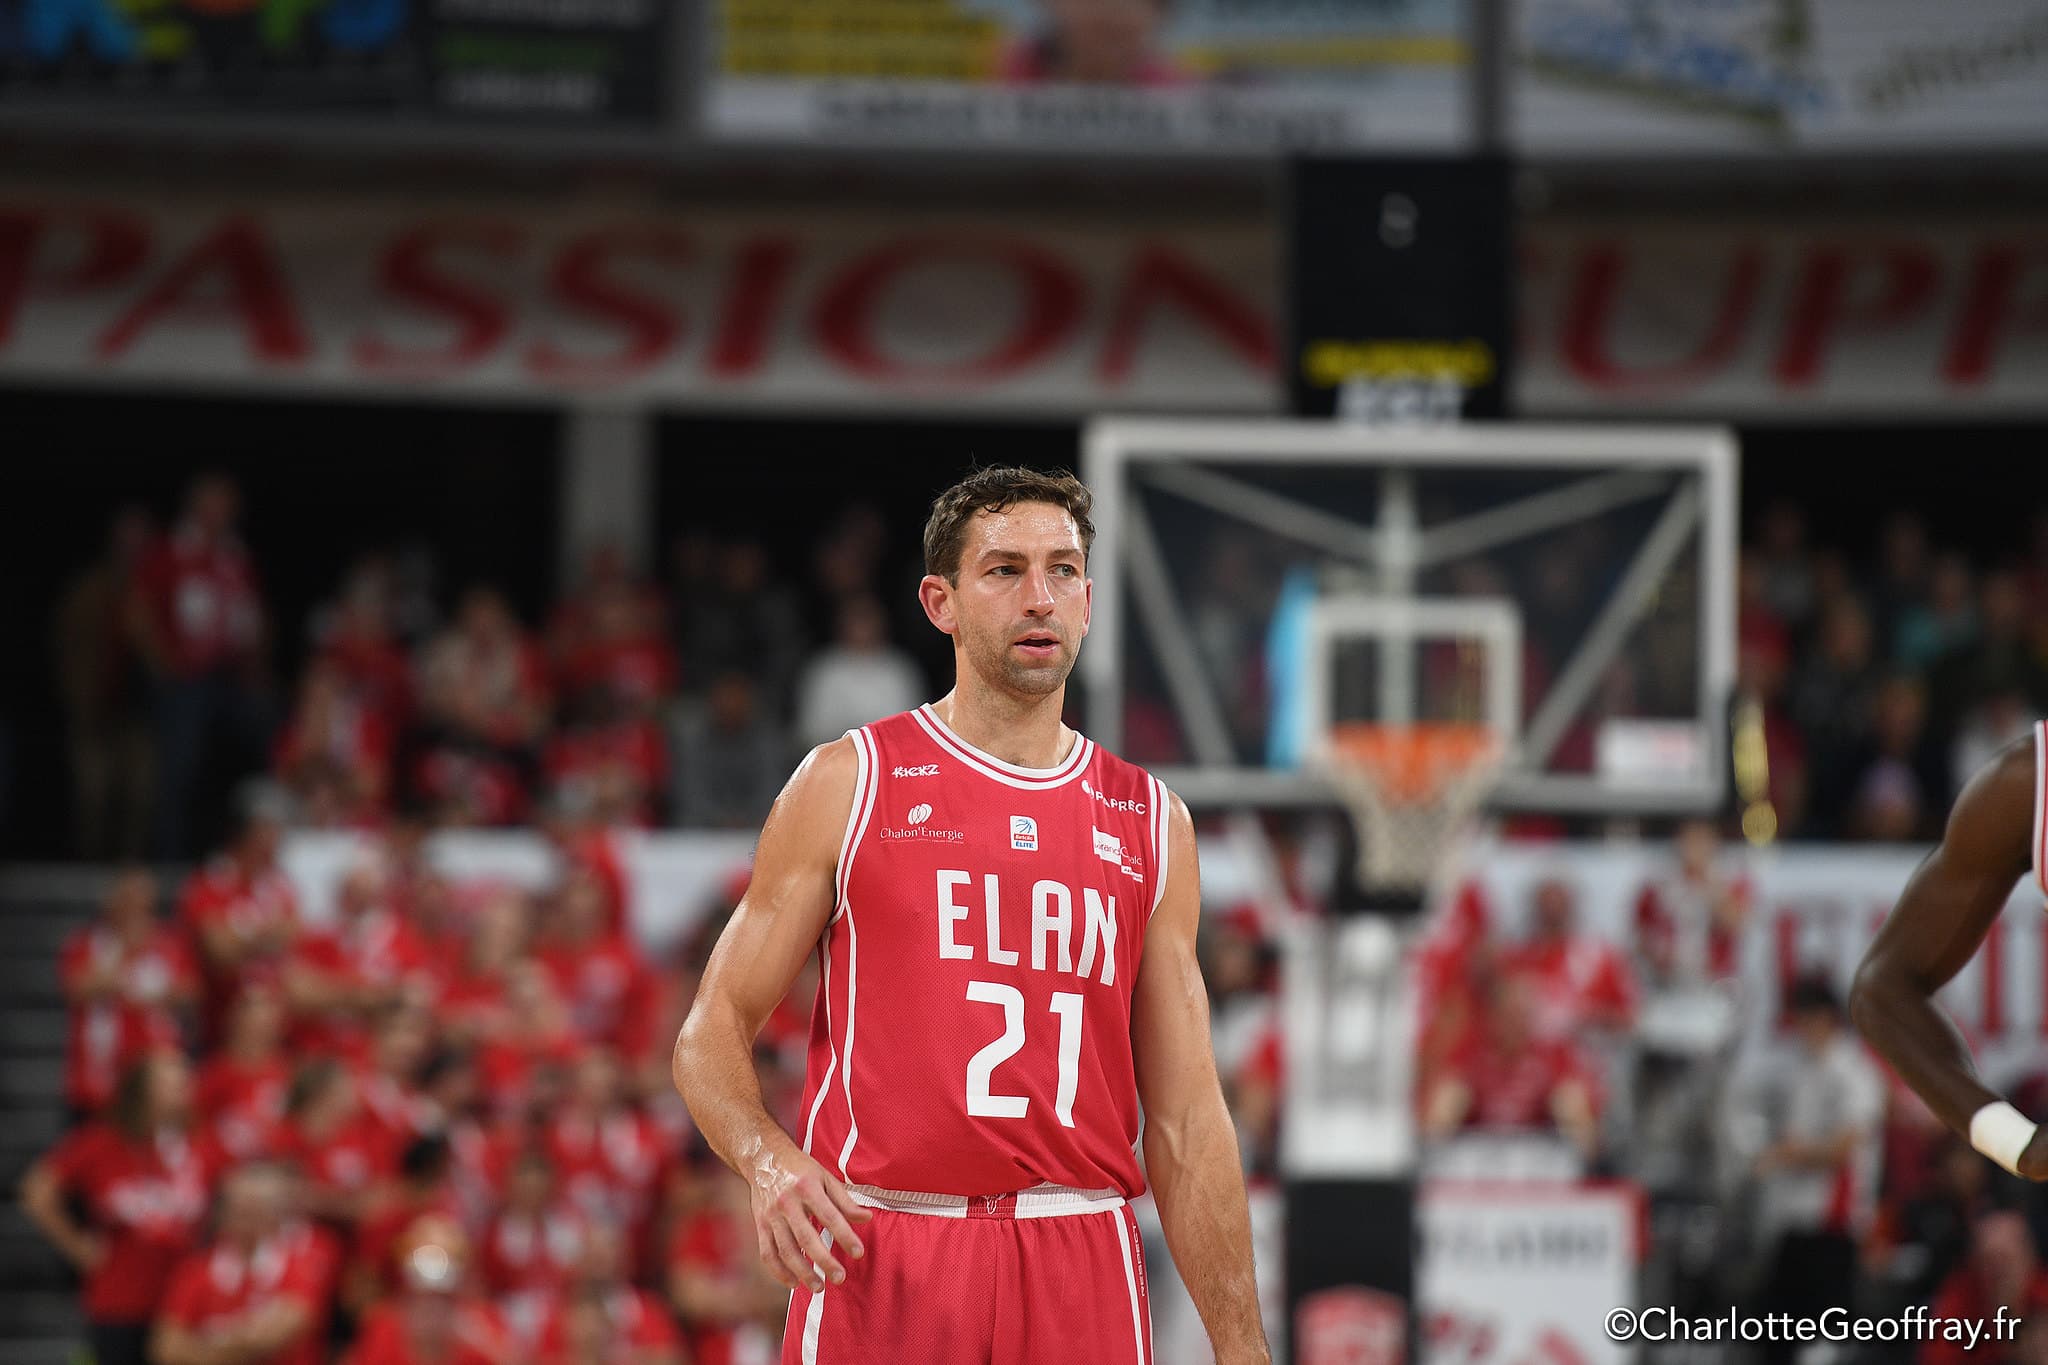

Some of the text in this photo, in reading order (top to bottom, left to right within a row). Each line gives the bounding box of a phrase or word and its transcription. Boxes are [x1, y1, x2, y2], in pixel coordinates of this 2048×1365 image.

[0, 206, 1282, 388] PASSION
[1096, 790, 1146, 814] PAPREC
[937, 869, 1117, 987] ELAN
[965, 980, 1084, 1129] 21
